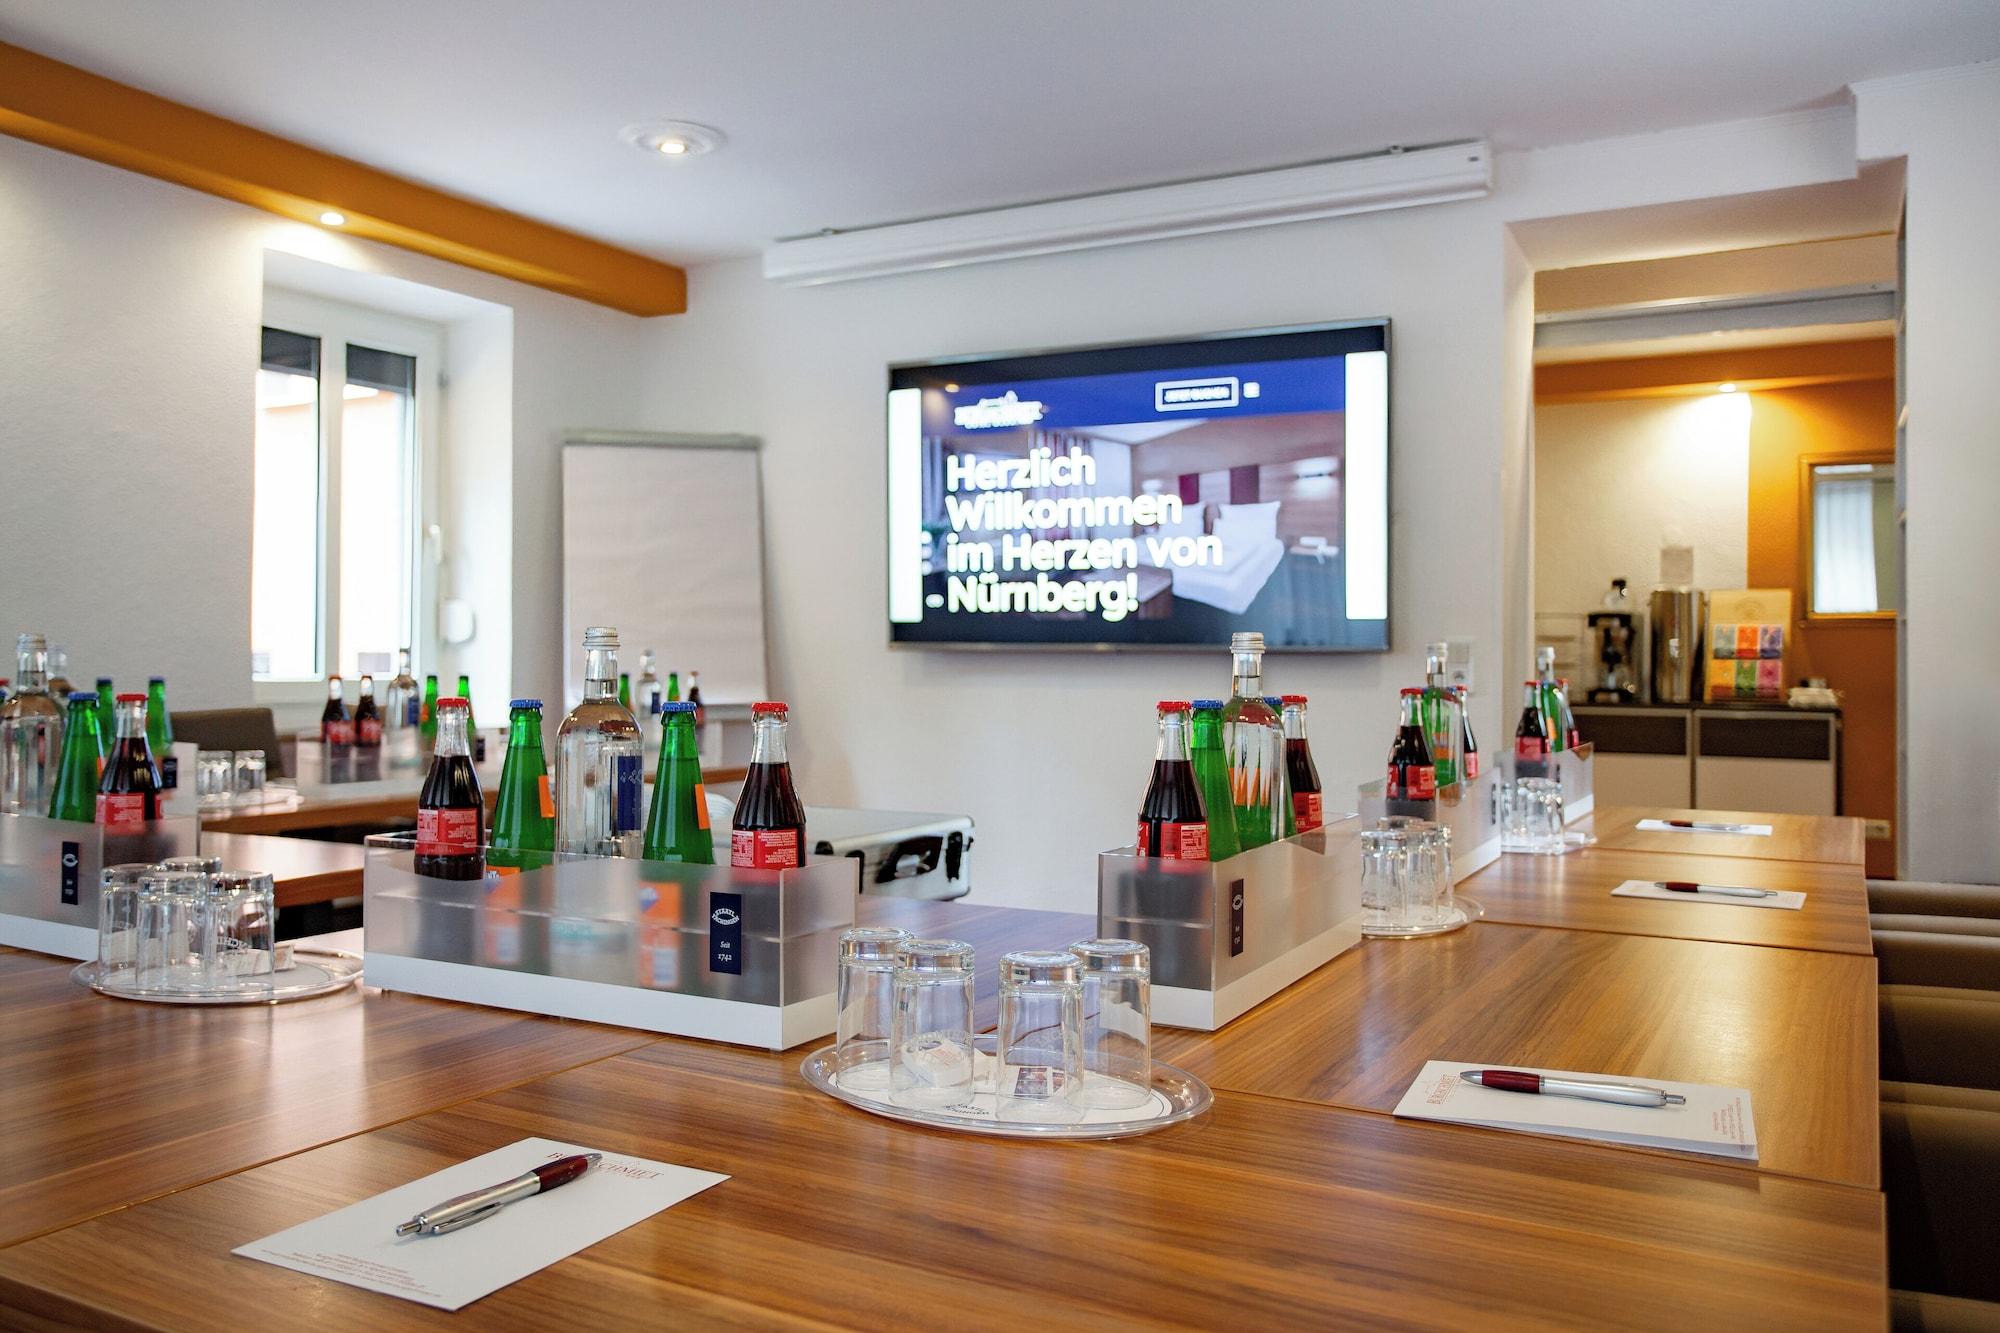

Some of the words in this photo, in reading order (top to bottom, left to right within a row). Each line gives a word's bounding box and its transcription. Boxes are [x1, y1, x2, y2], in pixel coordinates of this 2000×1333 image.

[946, 447, 1096, 492] Herzlich
[945, 491, 1183, 532] Willkommen
[946, 533, 994, 572] im
[1002, 533, 1138, 571] Herzen
[1146, 535, 1223, 567] von
[947, 572, 1139, 622] Nürnberg!
[717, 953, 733, 962] 1742
[720, 940, 731, 949] Seit
